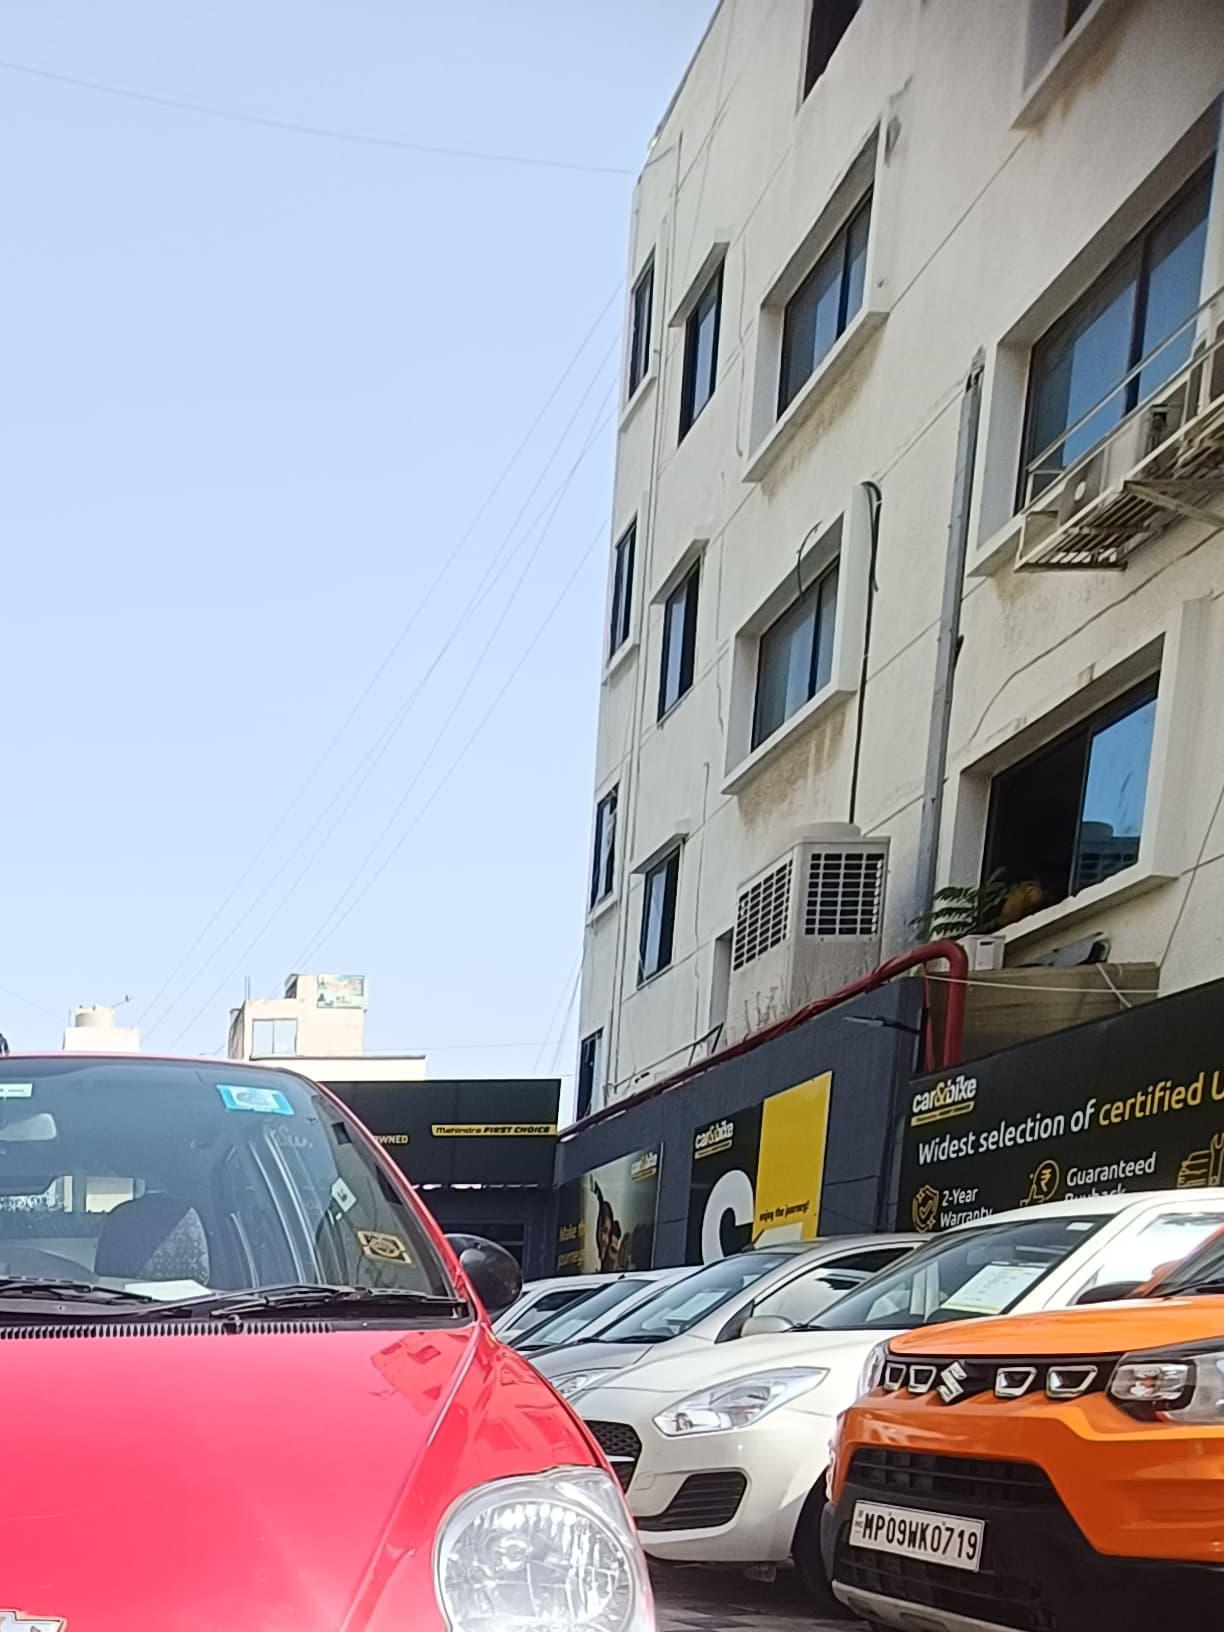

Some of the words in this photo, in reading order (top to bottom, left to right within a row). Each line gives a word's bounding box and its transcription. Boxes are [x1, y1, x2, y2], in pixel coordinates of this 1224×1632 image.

[912, 1074, 977, 1113] car&bike
[435, 1126, 482, 1134] Mahindra
[483, 1126, 512, 1134] FIRST
[513, 1126, 551, 1134] CHOICE
[918, 1131, 977, 1166] Widest
[978, 1103, 1065, 1152] selection
[1070, 1098, 1097, 1132] of
[1098, 1072, 1205, 1126] certified
[1066, 1151, 1157, 1187] Guaranteed
[941, 1187, 979, 1207] 2-Year
[862, 1512, 978, 1560] MP09WK0719
